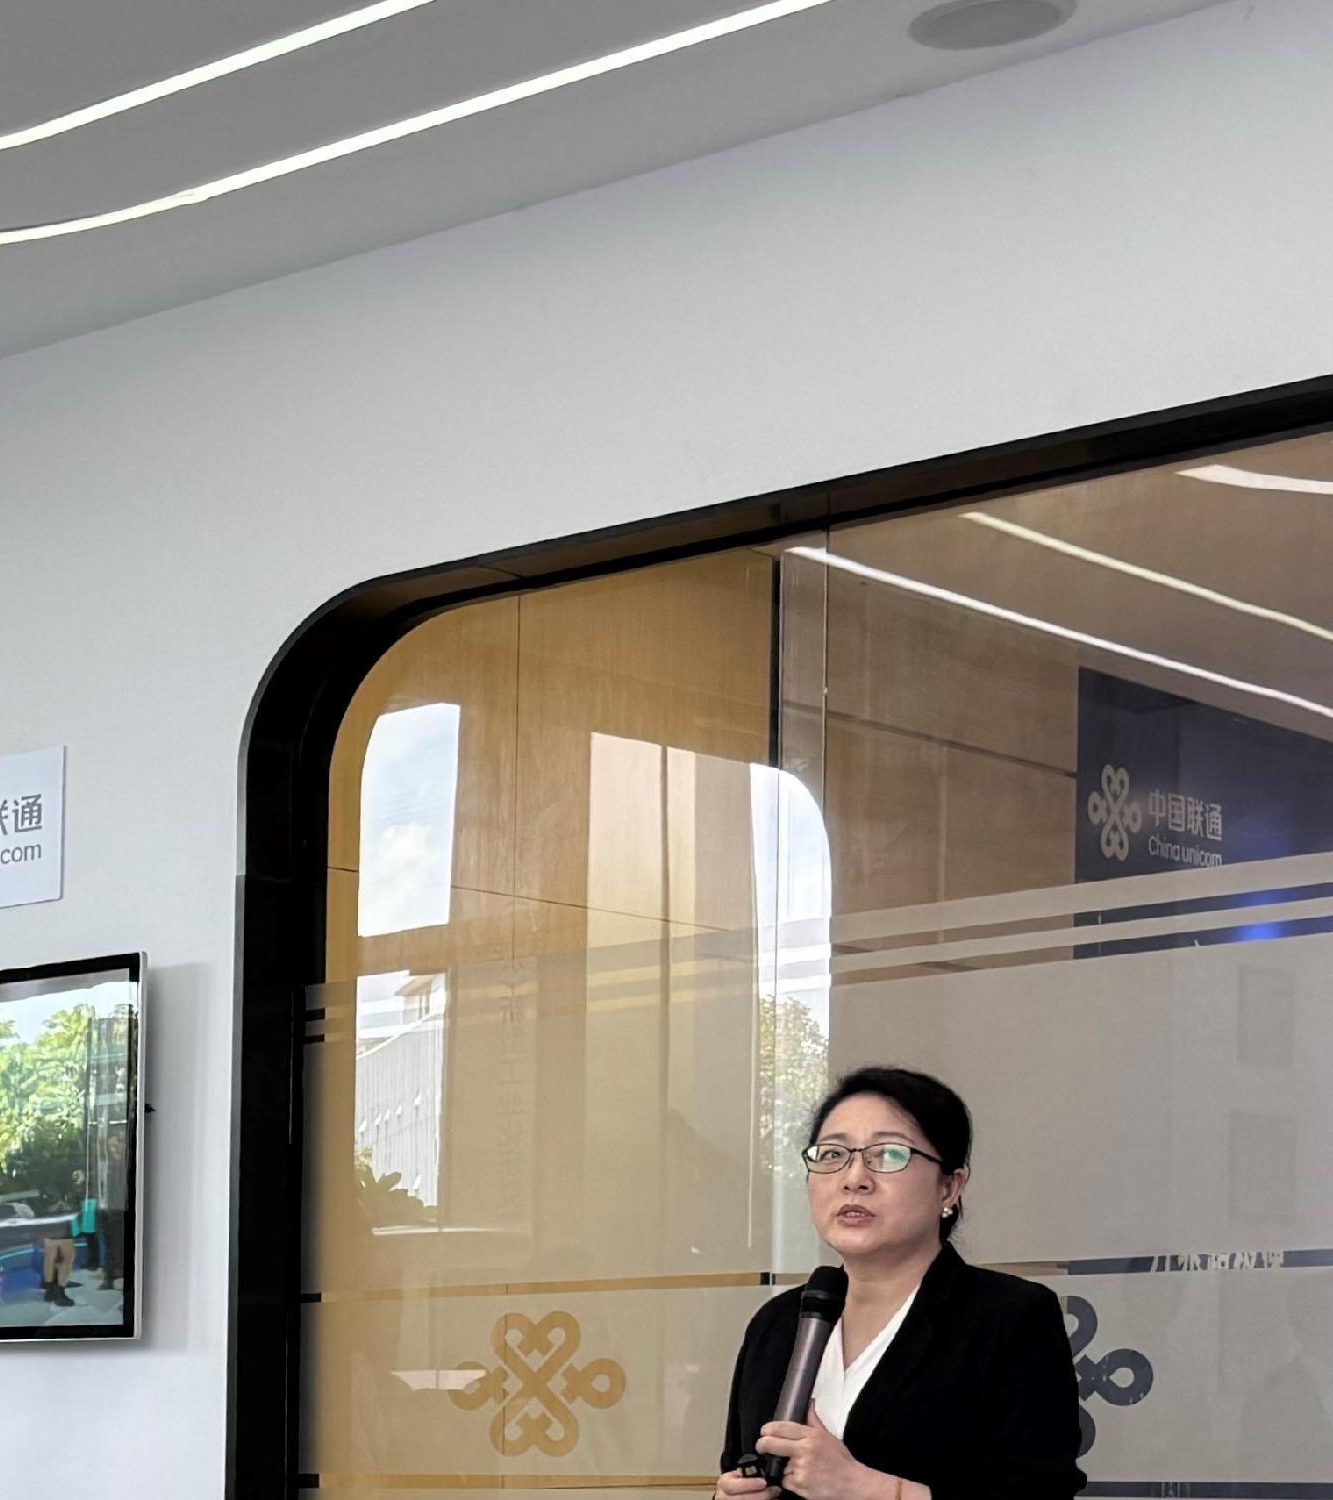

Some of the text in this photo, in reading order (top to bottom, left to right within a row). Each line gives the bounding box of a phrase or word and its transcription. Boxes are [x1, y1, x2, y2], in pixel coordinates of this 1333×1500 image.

[1150, 789, 1221, 840] 中国联通
[1148, 834, 1222, 868] China unicom
